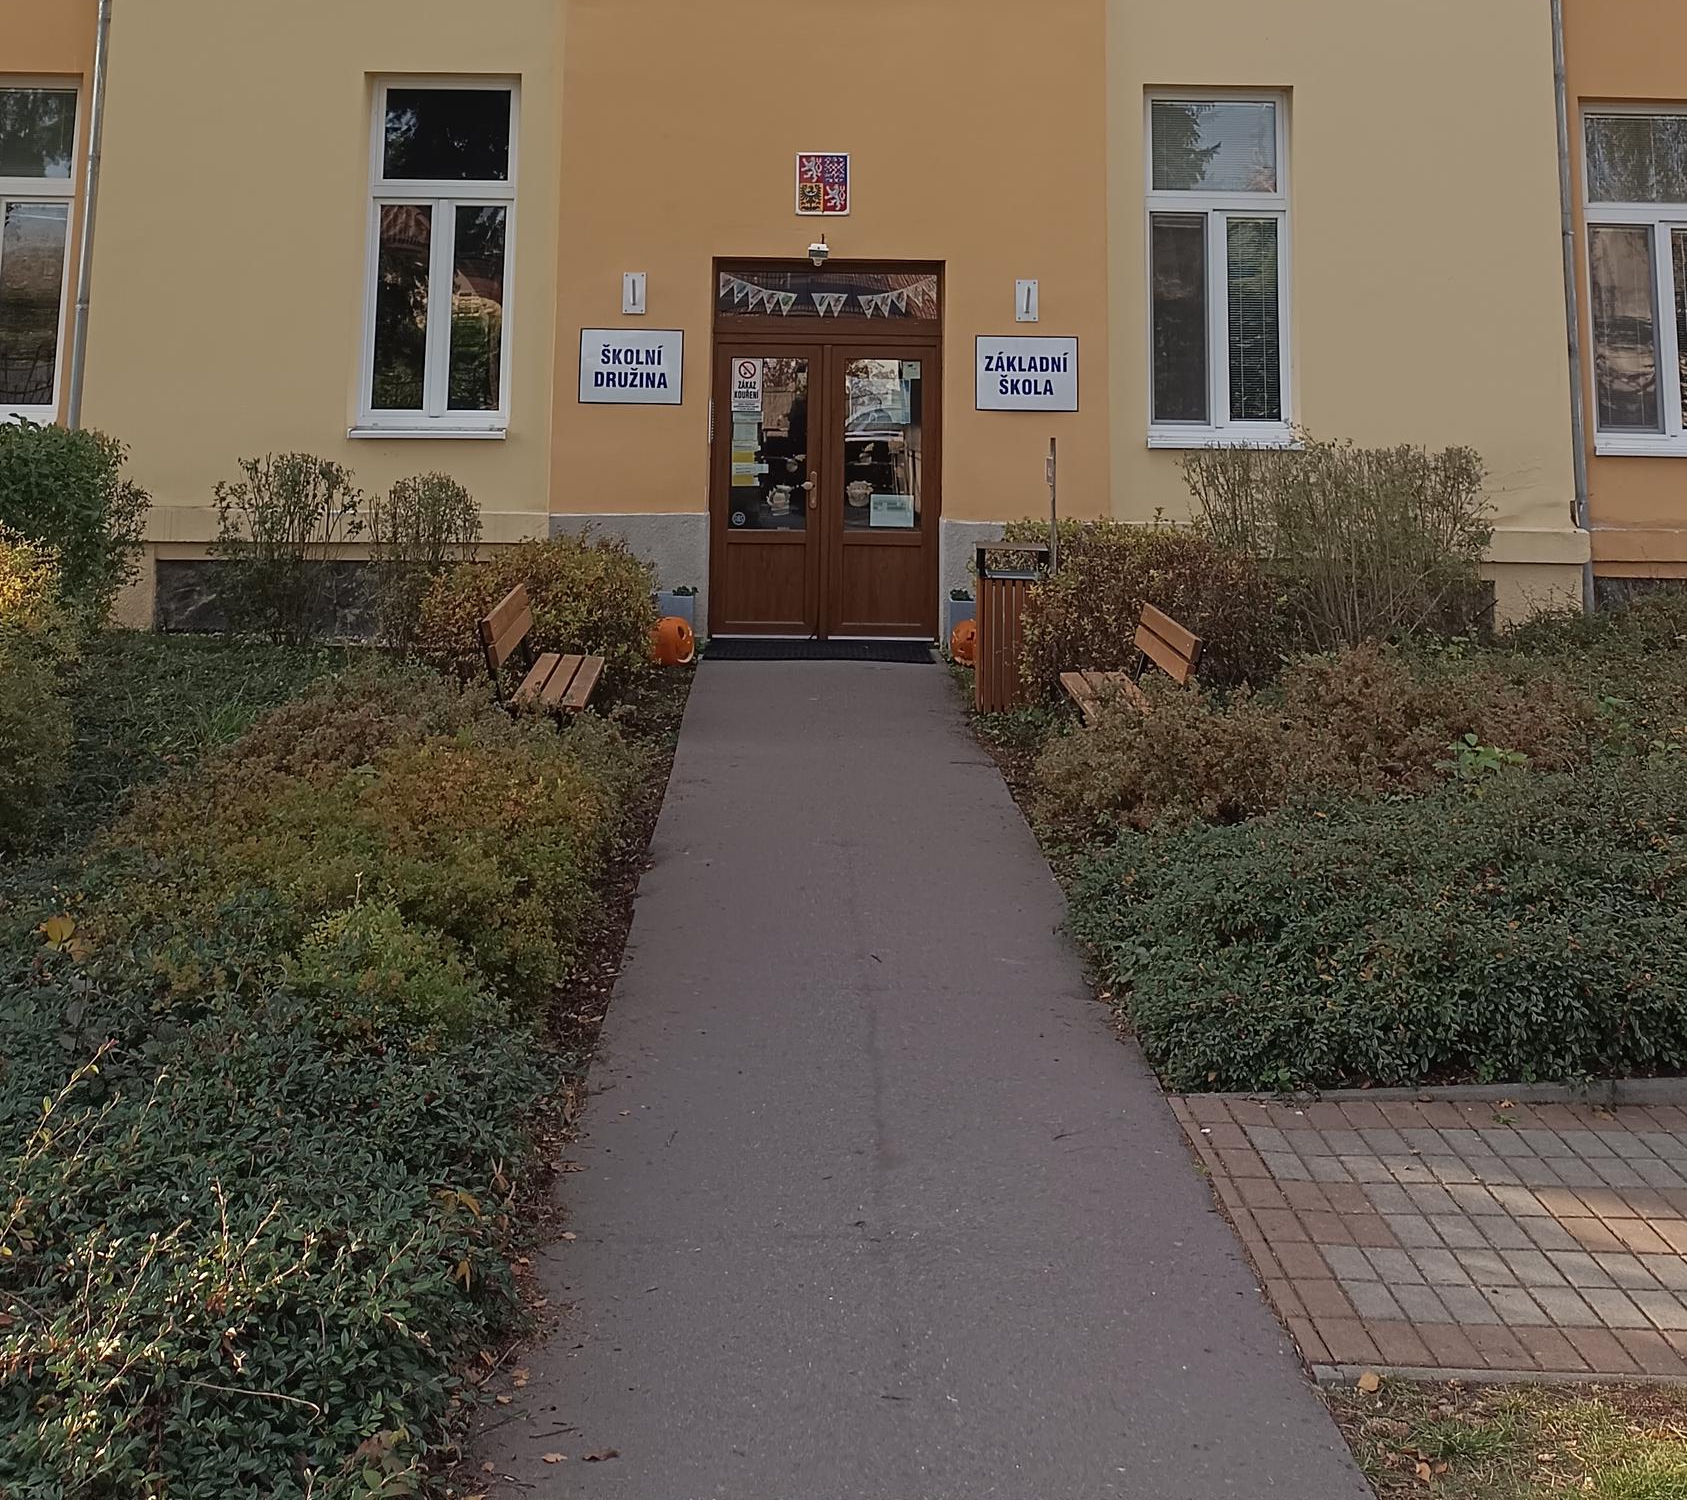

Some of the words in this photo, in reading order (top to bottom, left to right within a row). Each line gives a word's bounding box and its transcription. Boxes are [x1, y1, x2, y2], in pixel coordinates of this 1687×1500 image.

[601, 344, 663, 366] ŠKOLNÍ
[984, 351, 1068, 373] ZÁKLADNÍ
[594, 367, 668, 389] DRUŽINA
[738, 379, 757, 389] ZÁKAZ
[999, 374, 1054, 396] ŠKOLA
[734, 389, 759, 399] KOUŘENÍ
